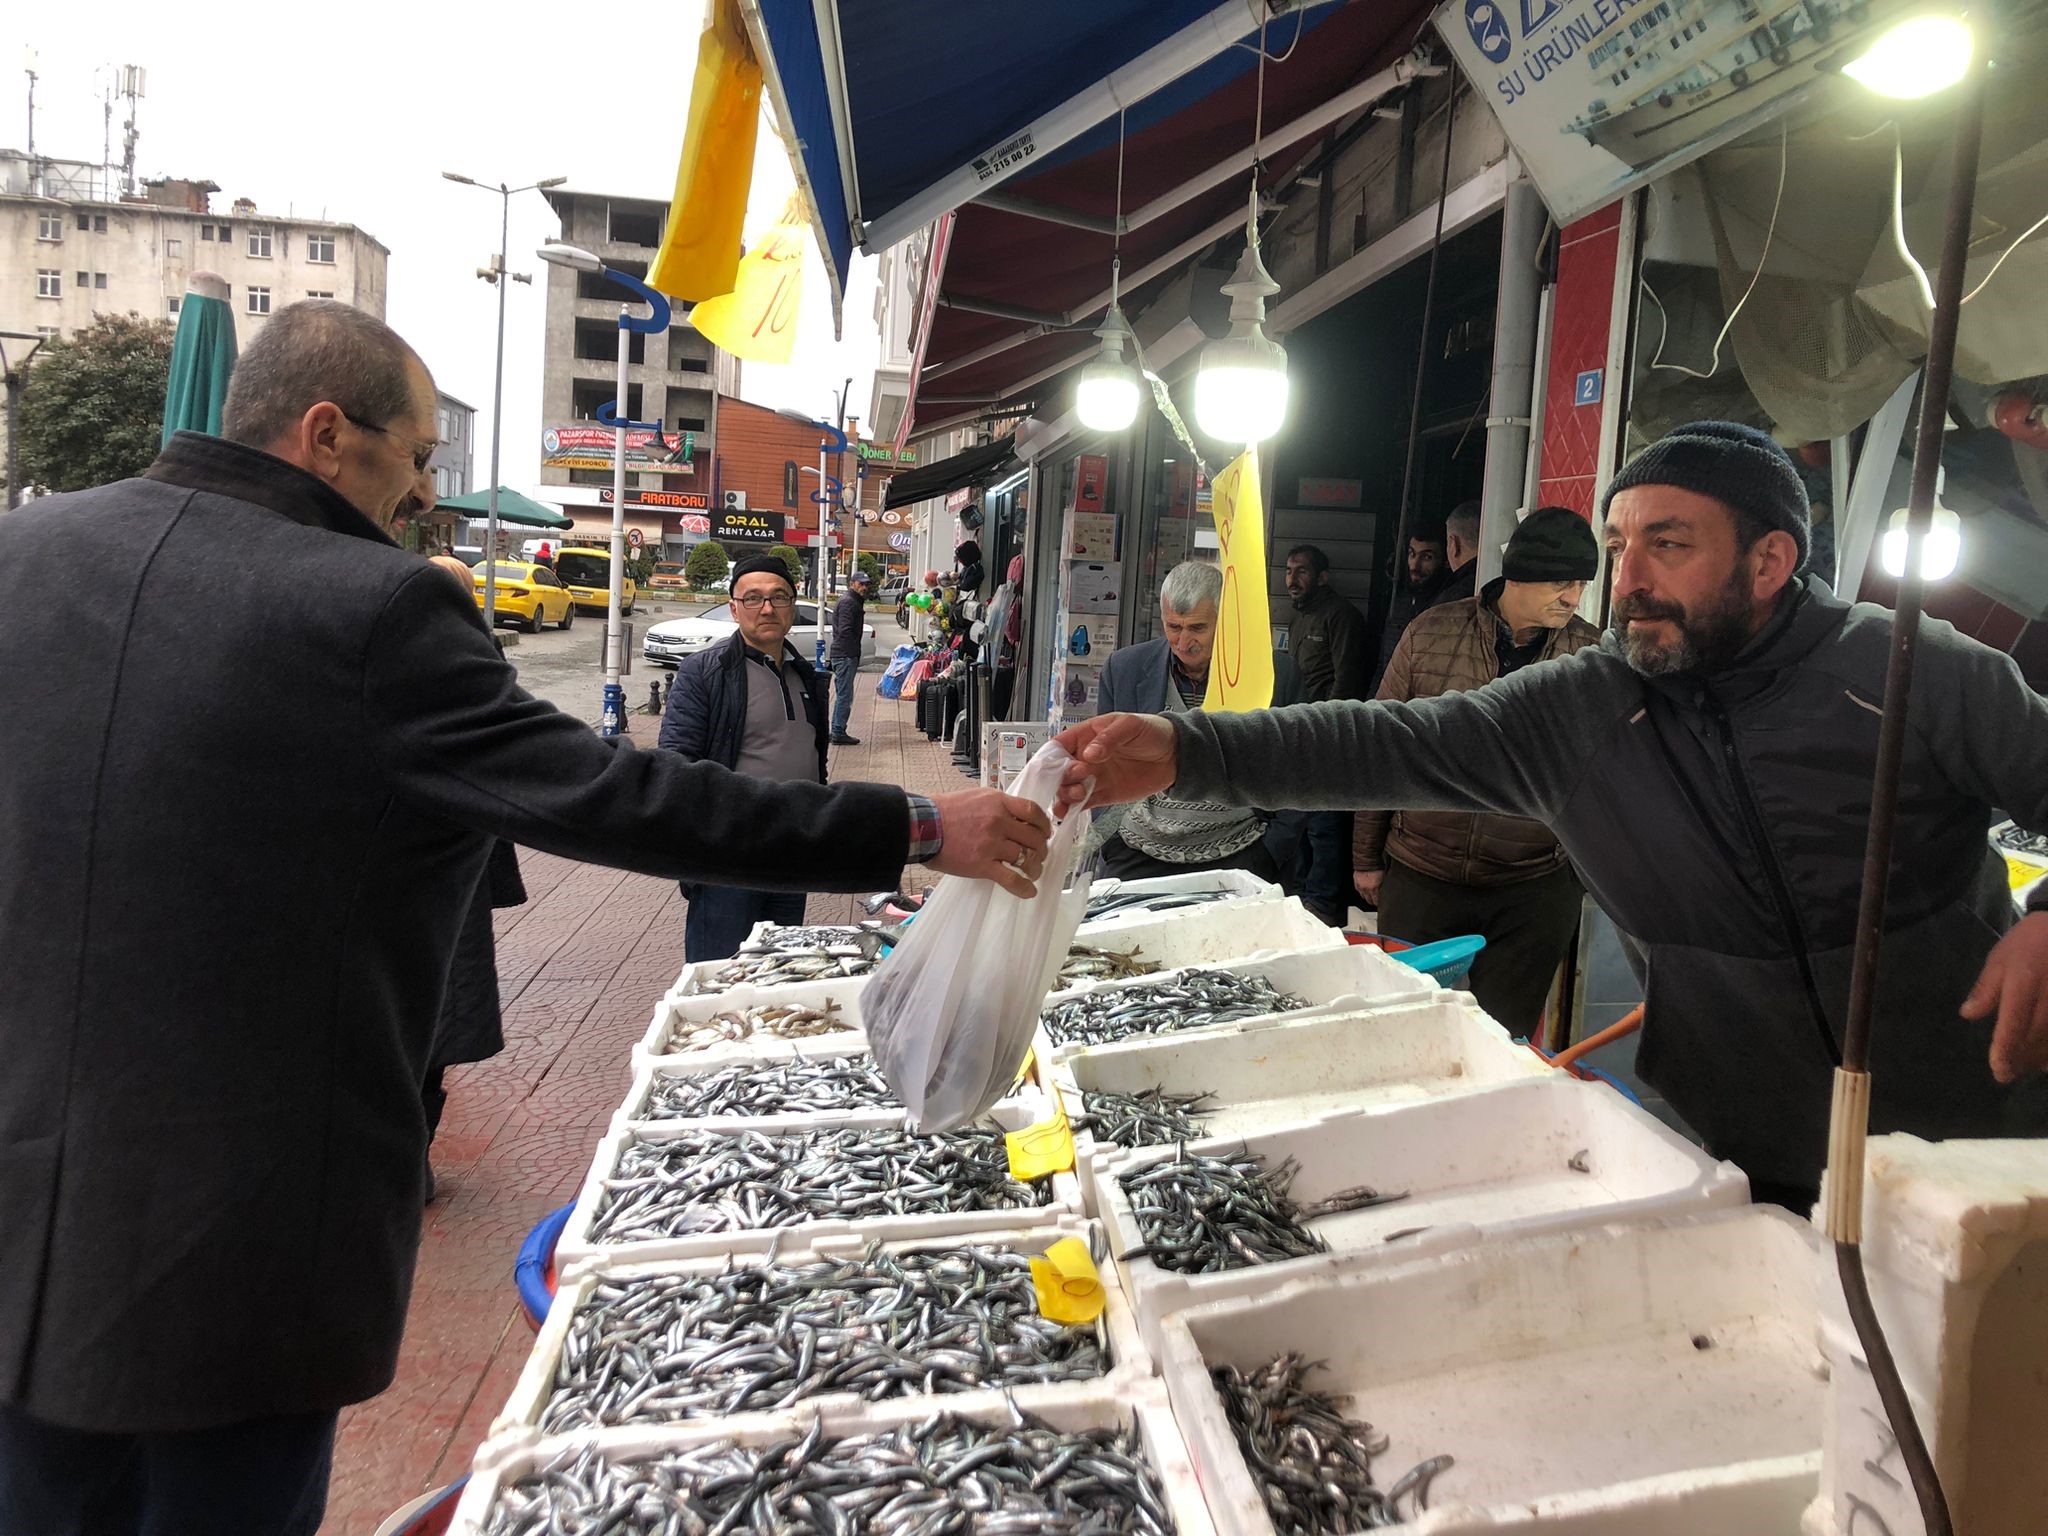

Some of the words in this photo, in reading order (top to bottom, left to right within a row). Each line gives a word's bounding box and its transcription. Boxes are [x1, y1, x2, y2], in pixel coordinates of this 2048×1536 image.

[1497, 69, 1526, 105] SU
[993, 158, 1011, 173] 215
[1010, 150, 1023, 162] 00
[1023, 143, 1036, 156] 22
[1583, 378, 1594, 398] 2
[640, 491, 706, 508] FIRATBORU
[725, 515, 769, 528] ORAL
